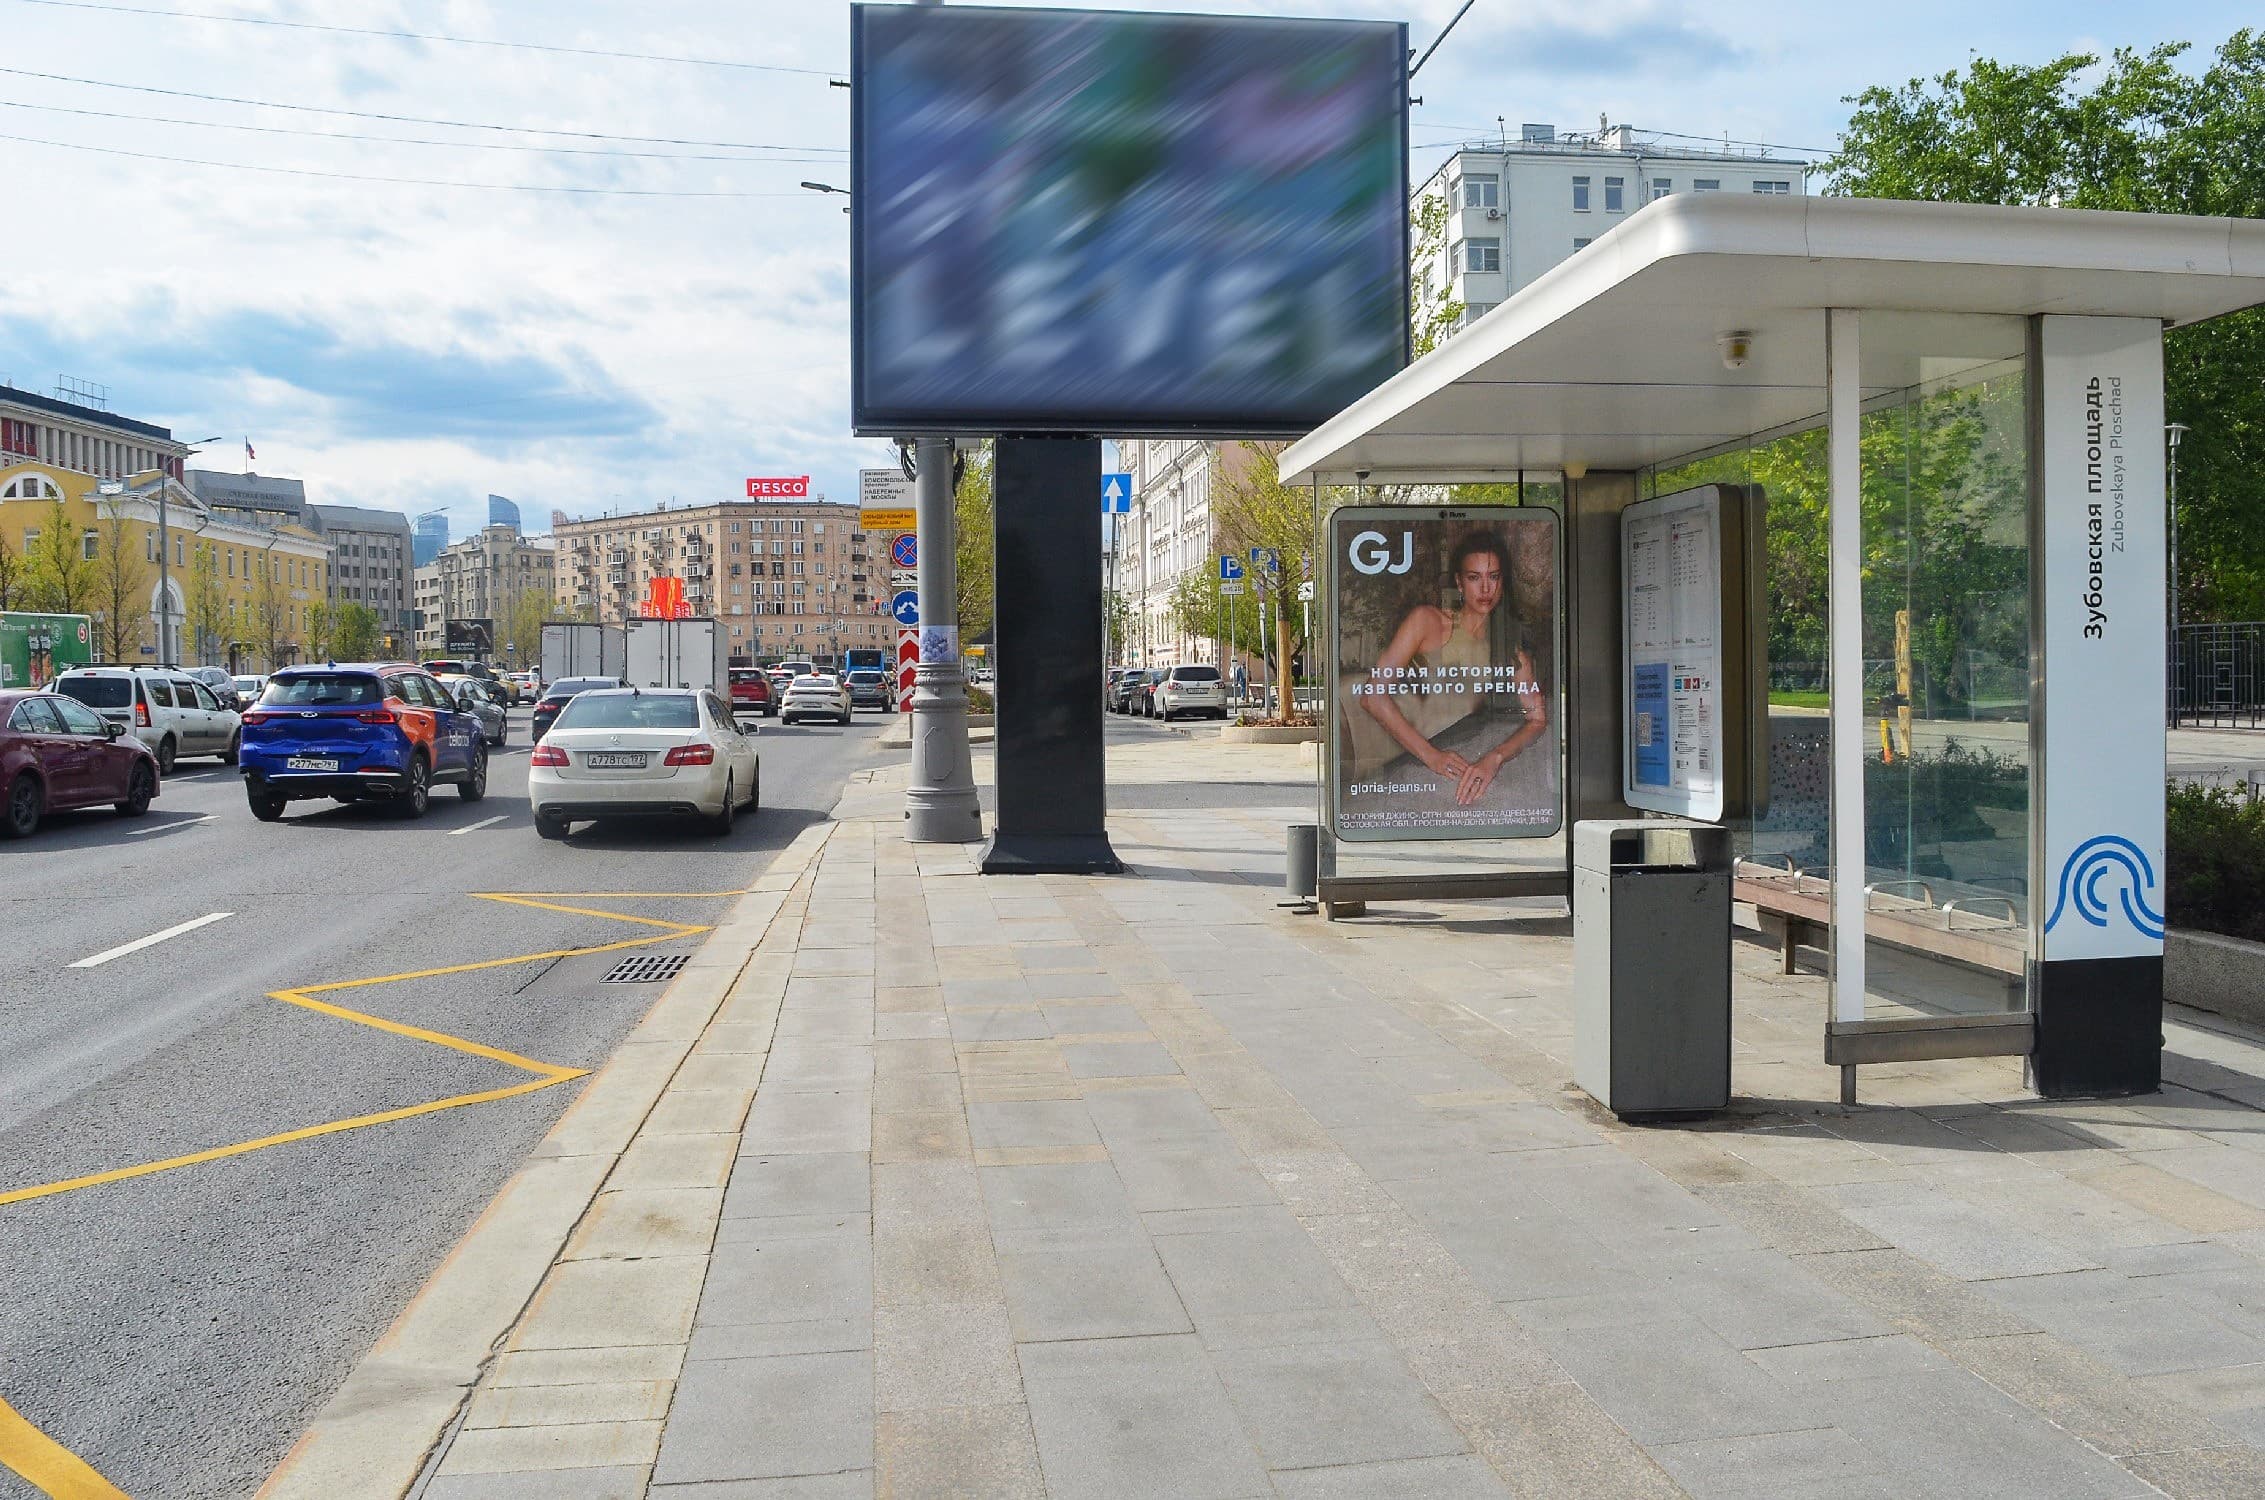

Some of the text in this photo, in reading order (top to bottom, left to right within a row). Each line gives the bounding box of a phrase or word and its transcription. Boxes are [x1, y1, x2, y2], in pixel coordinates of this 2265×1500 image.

[2107, 377, 2127, 552] Zubovskaya Ploschad
[751, 482, 804, 494] PESCO
[2083, 377, 2107, 639] Зубовская площадь
[1349, 530, 1413, 575] GJ
[1371, 666, 1515, 679] НОВАЯ ИСТОРИЯ
[1352, 682, 1540, 695] ИЗВЕСТНОГО БРЕНДА
[1350, 782, 1436, 796] gloria-jeans.ru
